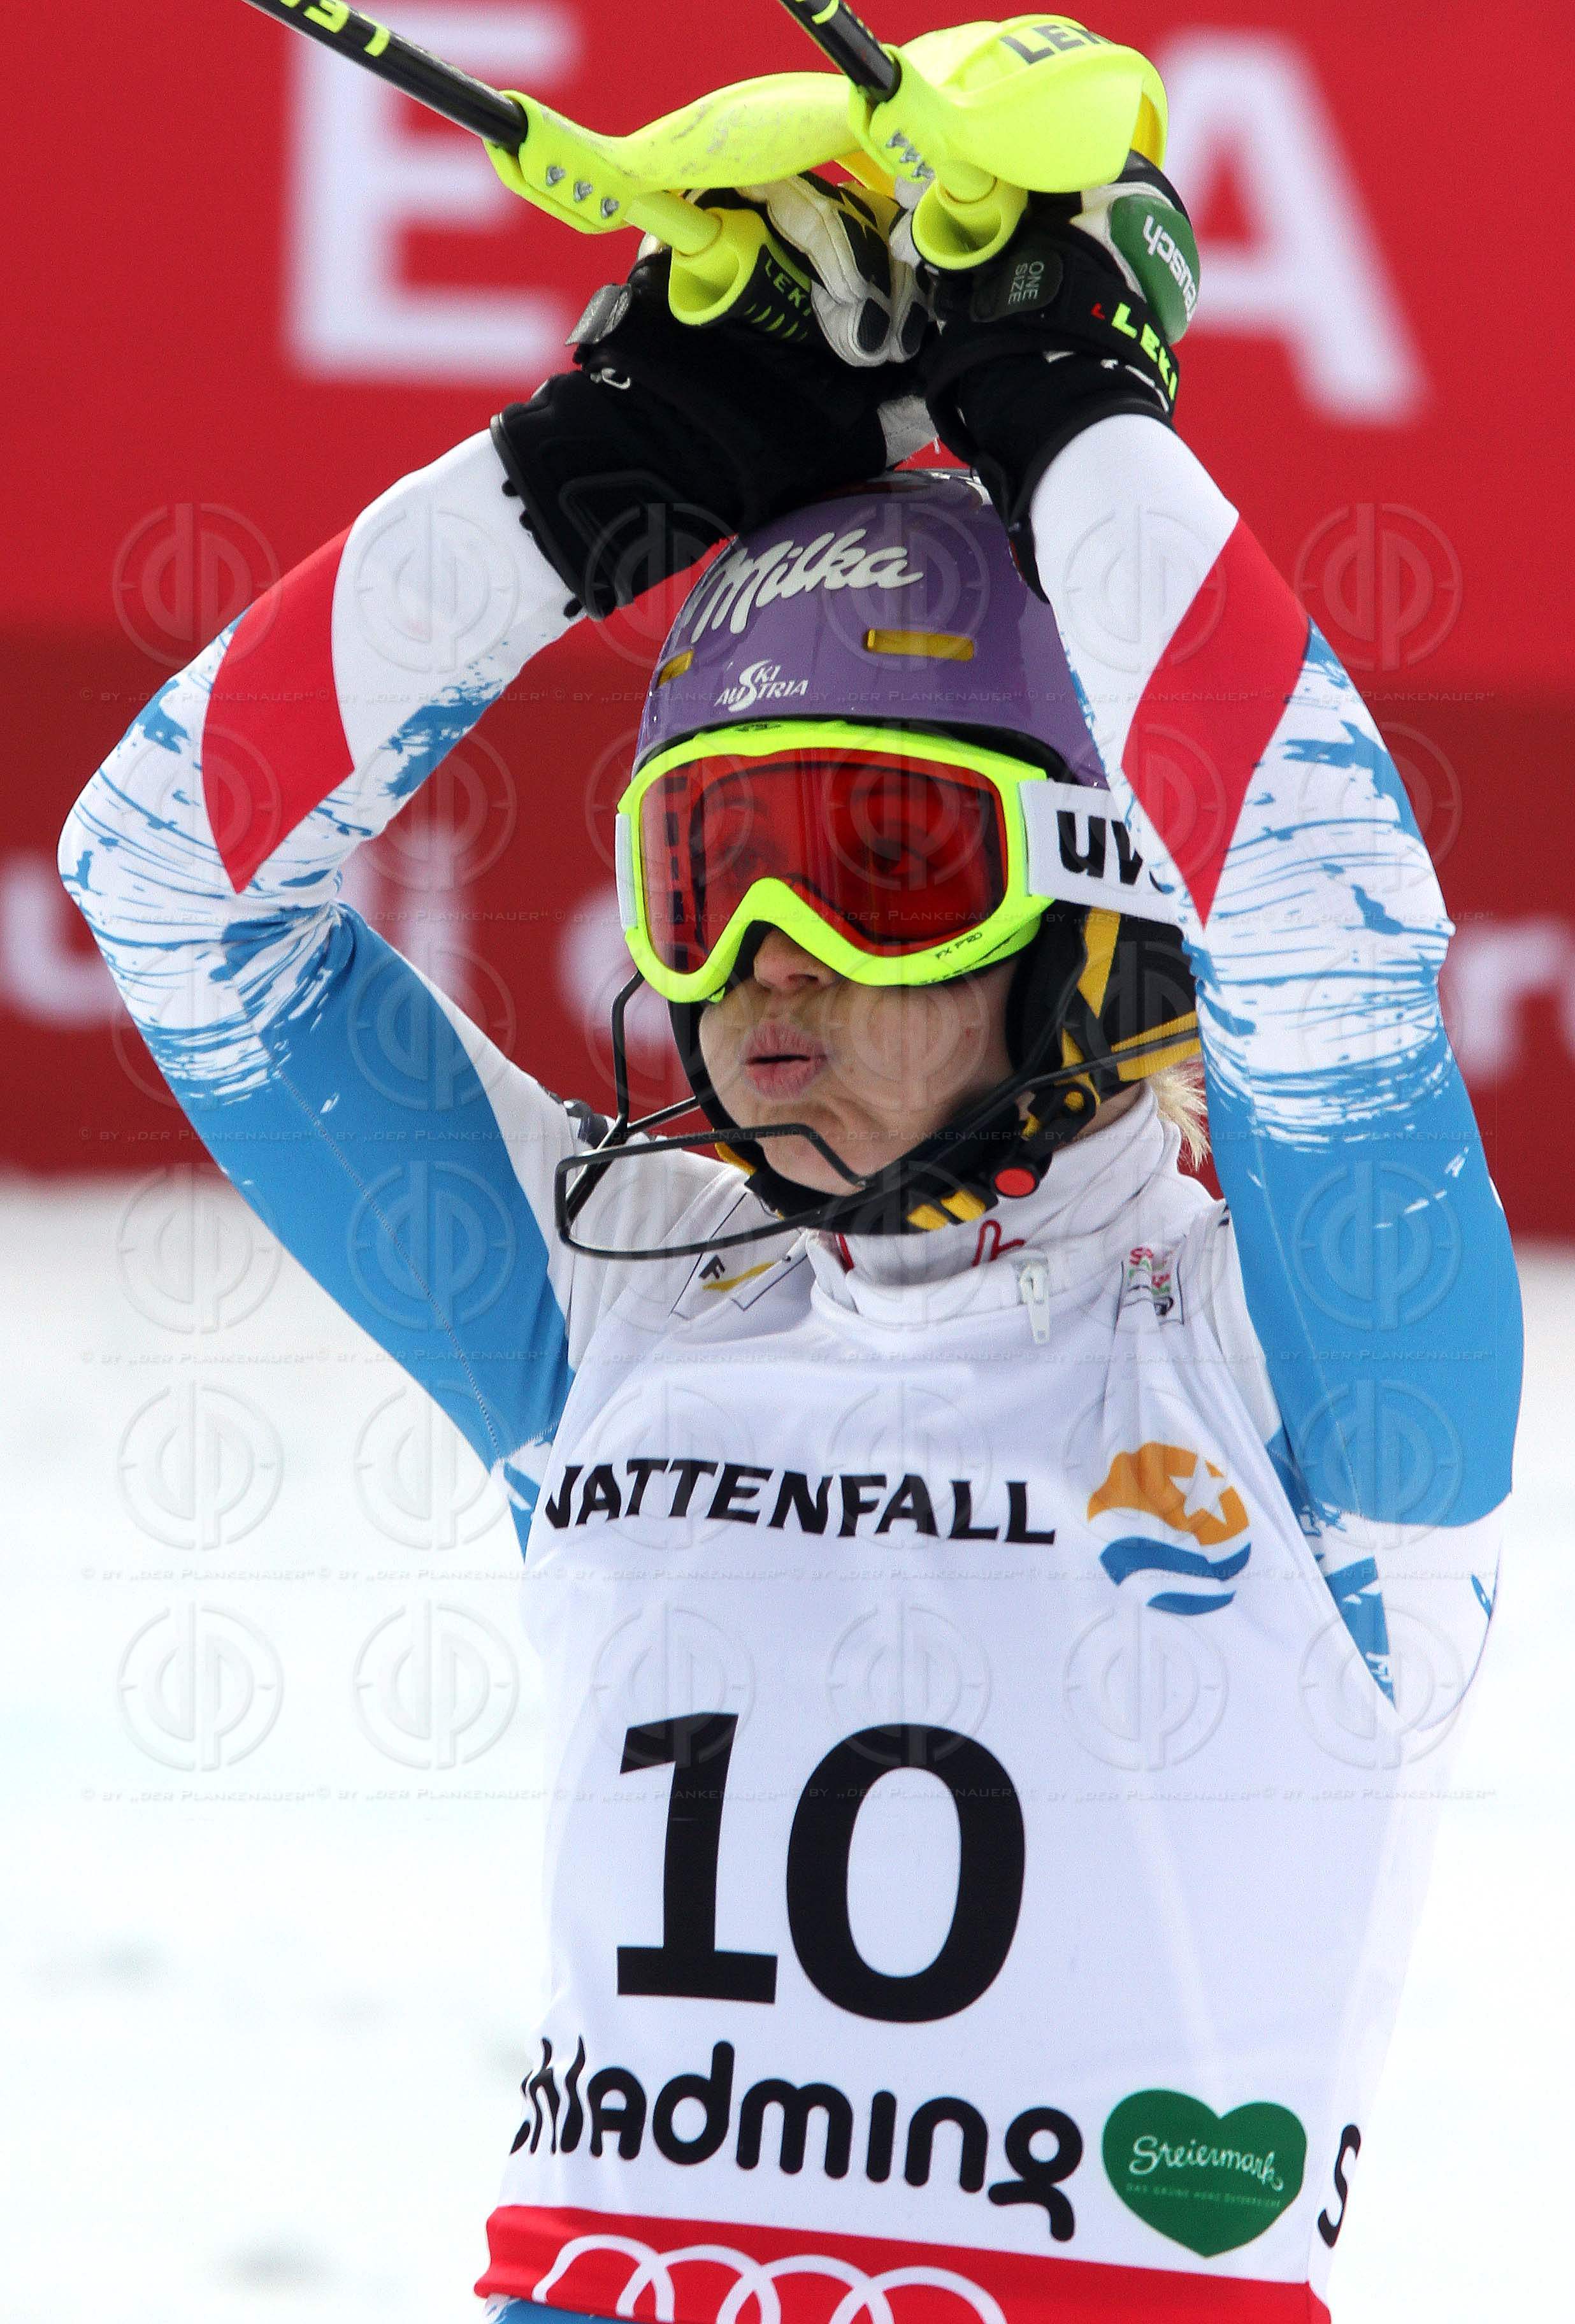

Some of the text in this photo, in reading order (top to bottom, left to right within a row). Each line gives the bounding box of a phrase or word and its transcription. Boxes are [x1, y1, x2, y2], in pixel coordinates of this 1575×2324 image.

[1111, 302, 1178, 401] LEKI
[680, 529, 924, 643] Milka
[616, 1711, 1026, 2024] 10
[1129, 2135, 1284, 2191] Steiermark
